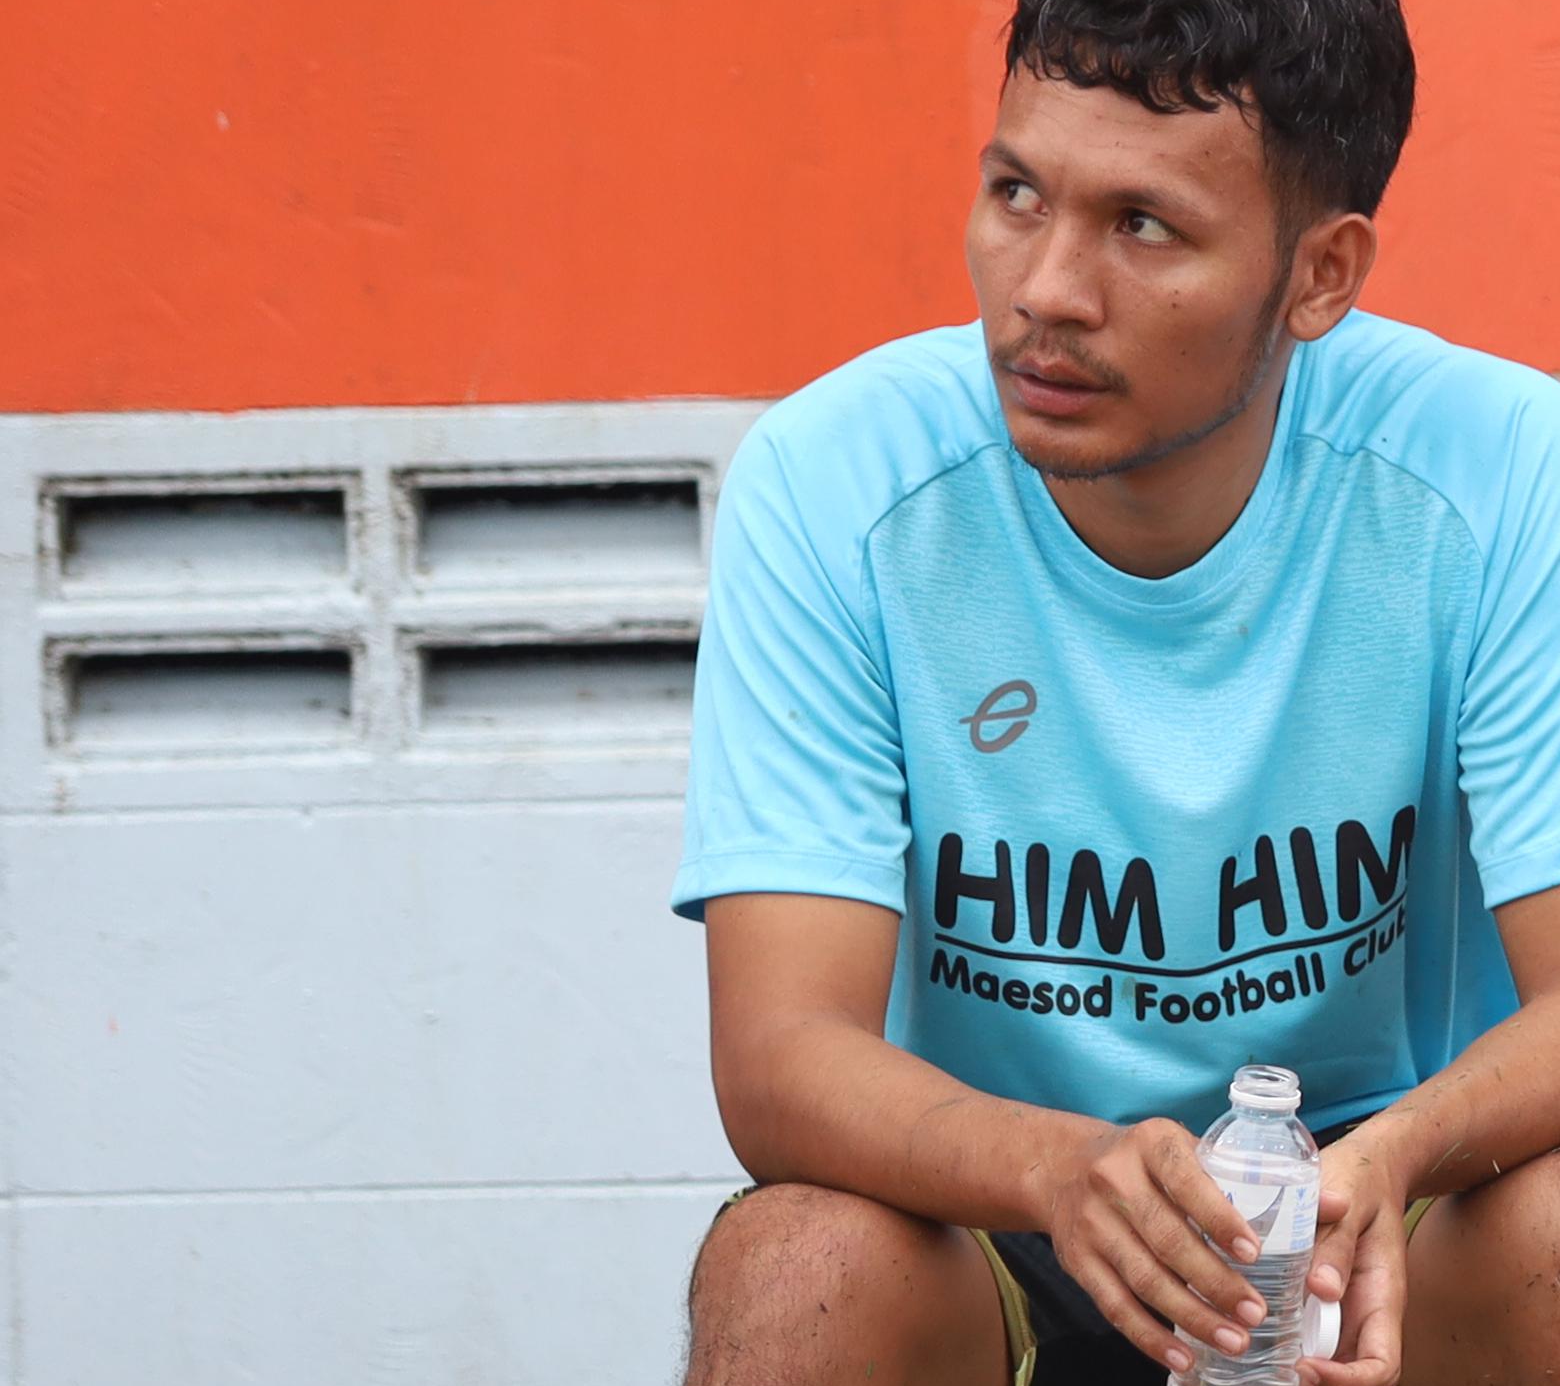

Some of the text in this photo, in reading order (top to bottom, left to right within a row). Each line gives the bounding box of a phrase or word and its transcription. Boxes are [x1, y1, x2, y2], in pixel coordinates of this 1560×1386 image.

[933, 804, 1417, 961] HIM HIM
[929, 948, 1112, 1018] Maesod
[1134, 951, 1326, 1024] Football
